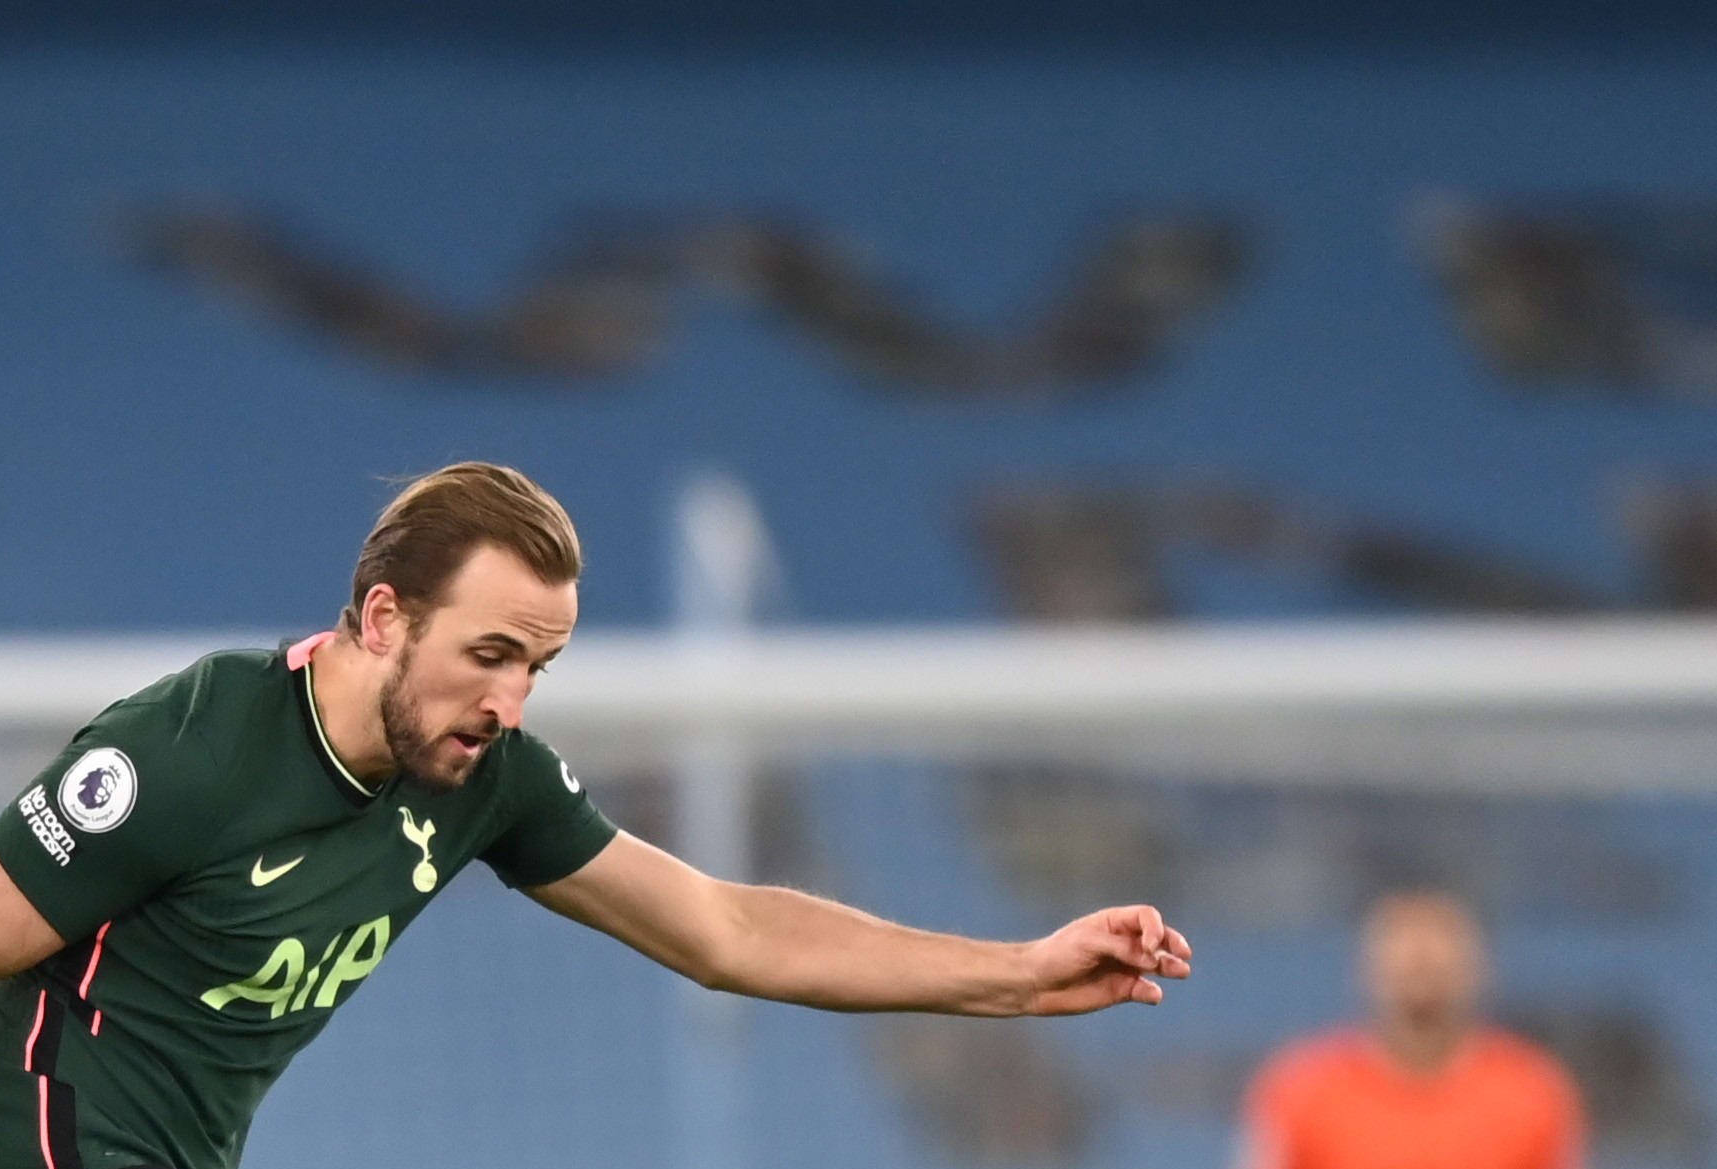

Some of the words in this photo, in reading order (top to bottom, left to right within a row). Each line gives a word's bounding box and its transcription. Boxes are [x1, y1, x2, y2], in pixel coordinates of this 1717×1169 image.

[27, 814, 71, 867] racism
[28, 784, 47, 810] No
[40, 806, 76, 852] room
